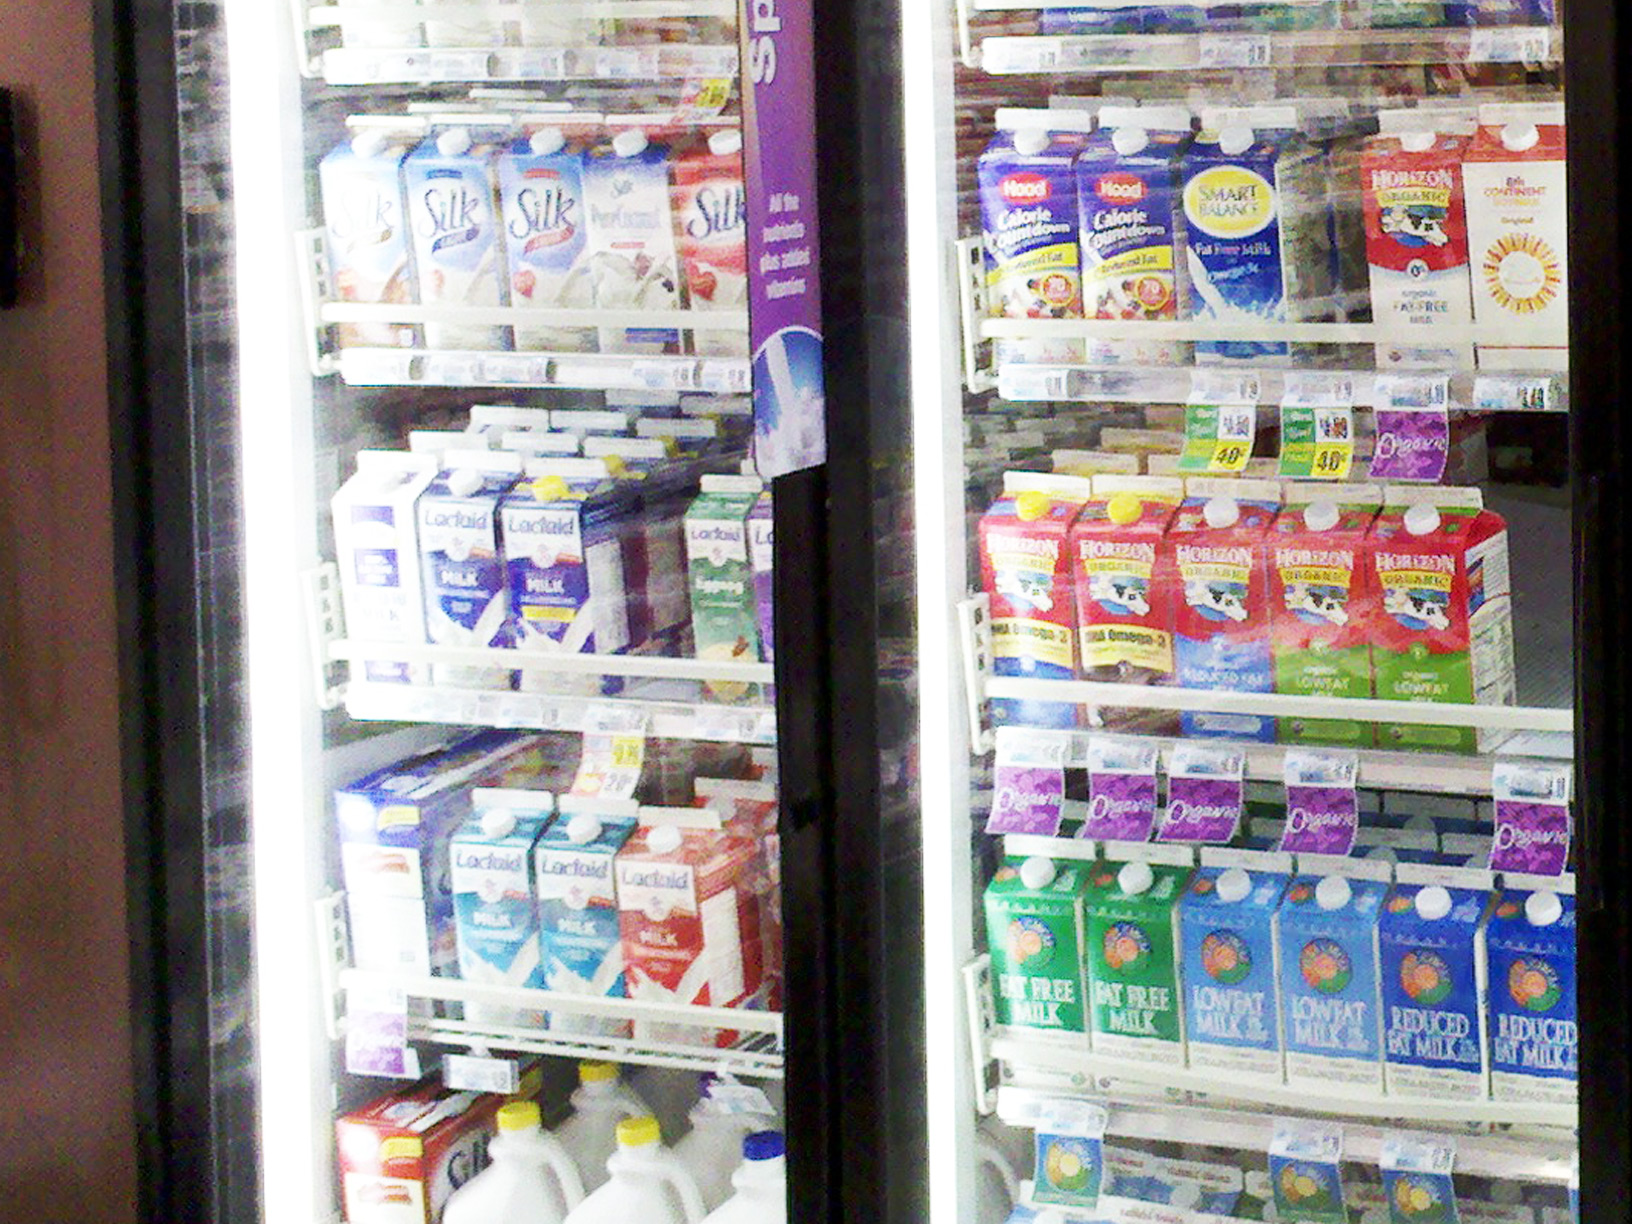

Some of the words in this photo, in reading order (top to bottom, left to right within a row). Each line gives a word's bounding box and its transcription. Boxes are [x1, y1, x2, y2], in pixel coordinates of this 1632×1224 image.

[1199, 184, 1258, 202] SMART
[1371, 170, 1453, 189] HORIZON
[418, 187, 480, 238] Silk
[509, 183, 577, 239] Silk
[687, 187, 747, 239] Silk
[424, 509, 488, 530] Lactaid
[508, 514, 574, 535] Lactaid
[690, 526, 741, 543] Lactaid
[986, 533, 1060, 560] HORIZON
[1079, 539, 1155, 563] HORIZON
[1176, 544, 1252, 569] HORIZON
[1276, 550, 1353, 570] HORIZON
[1375, 552, 1455, 575] HORIZON
[440, 569, 479, 587] MILK
[525, 577, 566, 594] MILK
[454, 850, 523, 873] Lactaid
[540, 854, 609, 879] Lactaid
[620, 868, 689, 890] Lactaid
[639, 929, 678, 947] MILK
[1030, 977, 1075, 1004] FREE
[1095, 980, 1123, 1007] FAT
[1126, 985, 1170, 1012] FREE
[1192, 984, 1265, 1015] LOWFAT
[1012, 1000, 1063, 1027] MILK
[1109, 1008, 1159, 1035] MILK
[1291, 995, 1369, 1022] LOWFAT
[1390, 1005, 1470, 1039] REDUCED
[1195, 1009, 1243, 1040] MILK
[1294, 1018, 1341, 1047] MILK
[1497, 1012, 1578, 1046] REDUCED
[1387, 1027, 1411, 1057] FAT
[1416, 1034, 1457, 1062] MILK
[1494, 1036, 1518, 1065] FAT
[1522, 1041, 1563, 1070] MILK
